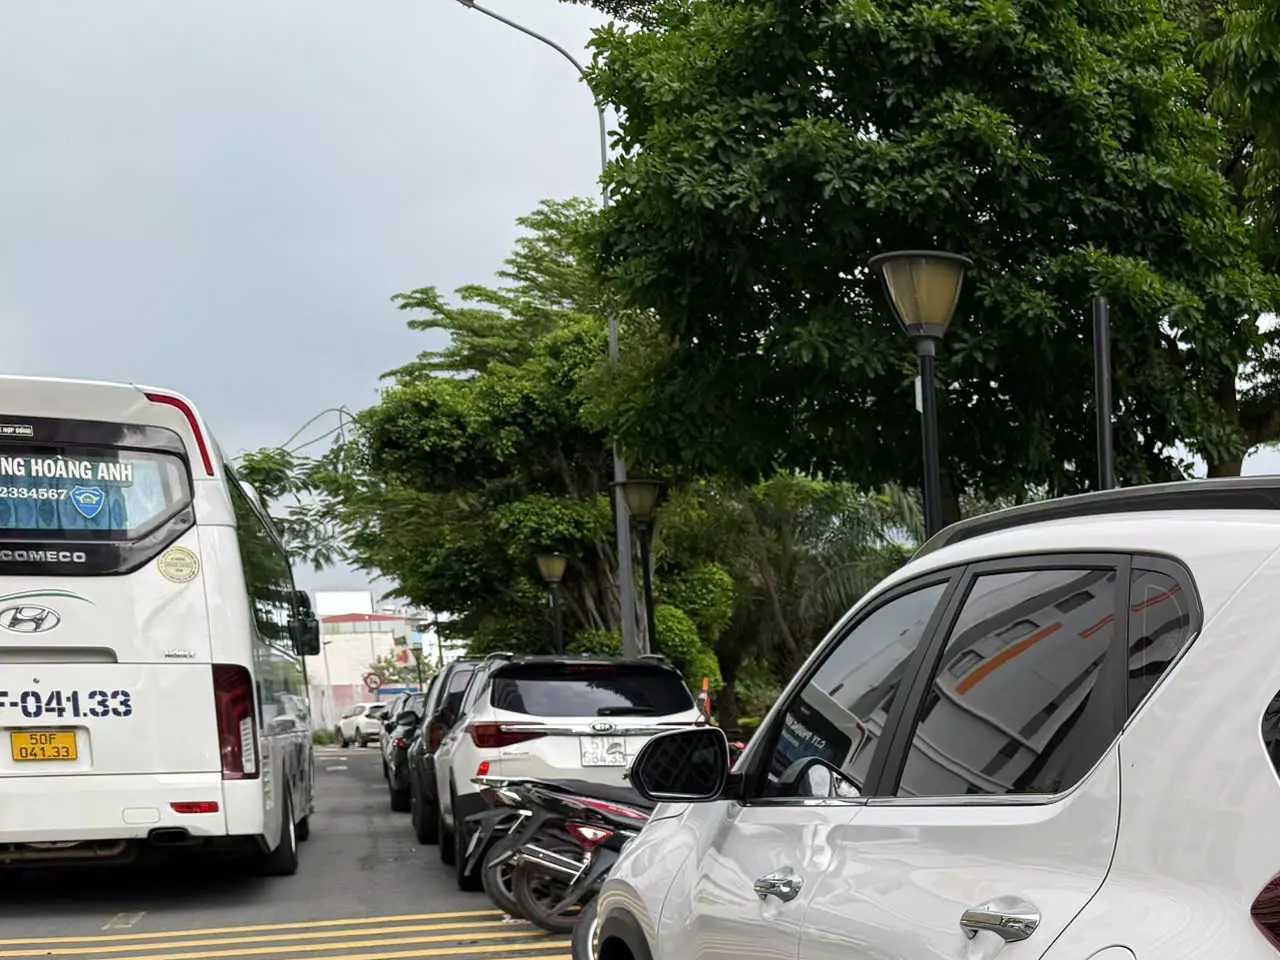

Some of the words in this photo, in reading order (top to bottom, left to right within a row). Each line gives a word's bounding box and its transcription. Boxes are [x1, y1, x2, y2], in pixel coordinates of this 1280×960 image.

[30, 455, 92, 480] HOÀNG
[97, 462, 132, 482] ANH
[29, 733, 56, 745] 50F
[19, 745, 70, 759] 041.33
